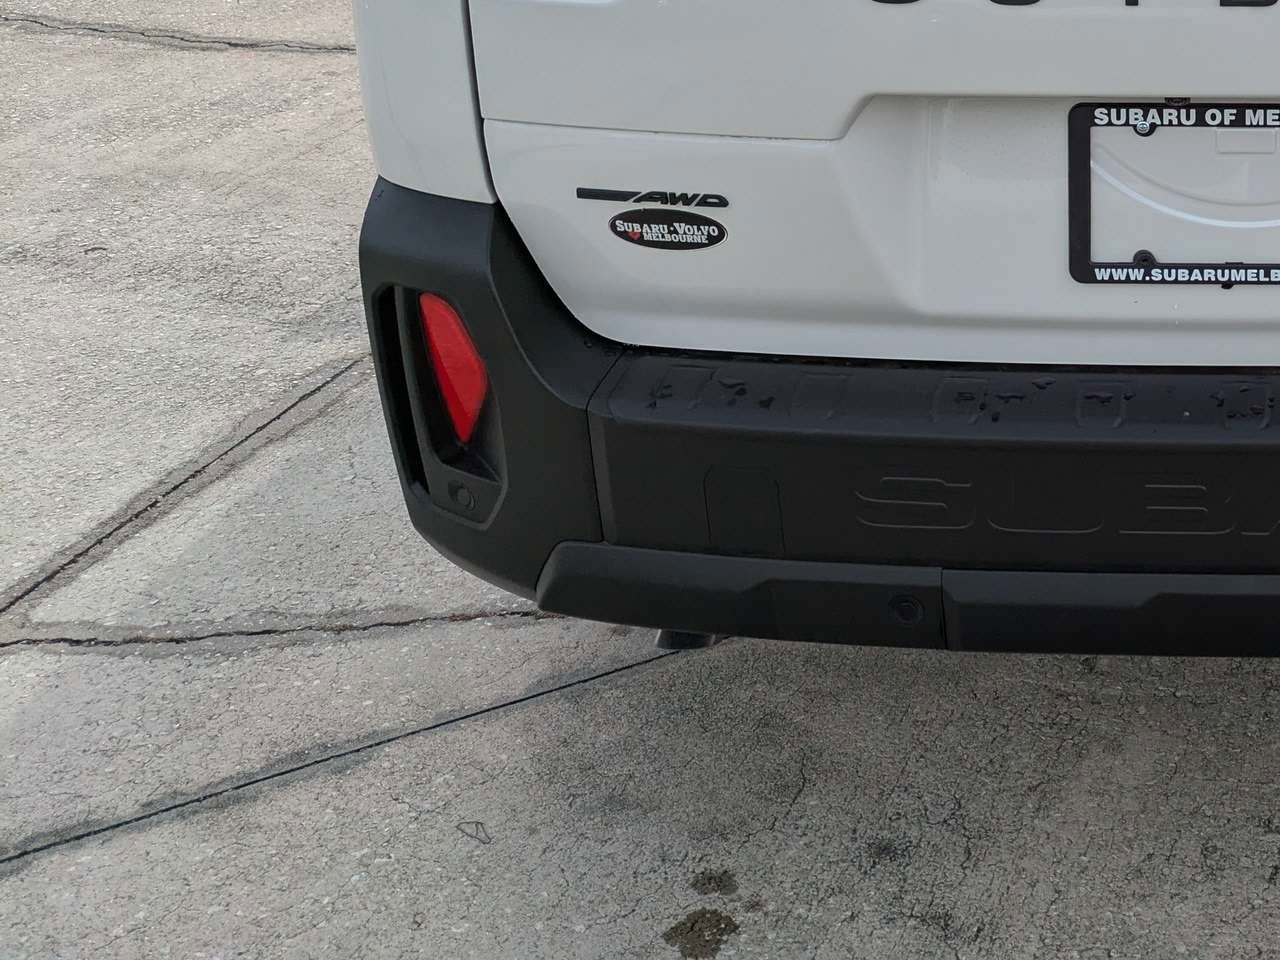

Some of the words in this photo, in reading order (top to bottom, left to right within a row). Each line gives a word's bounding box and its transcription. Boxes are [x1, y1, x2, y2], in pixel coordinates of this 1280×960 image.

[1094, 108, 1196, 126] SUBARU
[1205, 109, 1237, 126] OF
[631, 190, 730, 208] AWD
[643, 233, 708, 244] MELBOURNE
